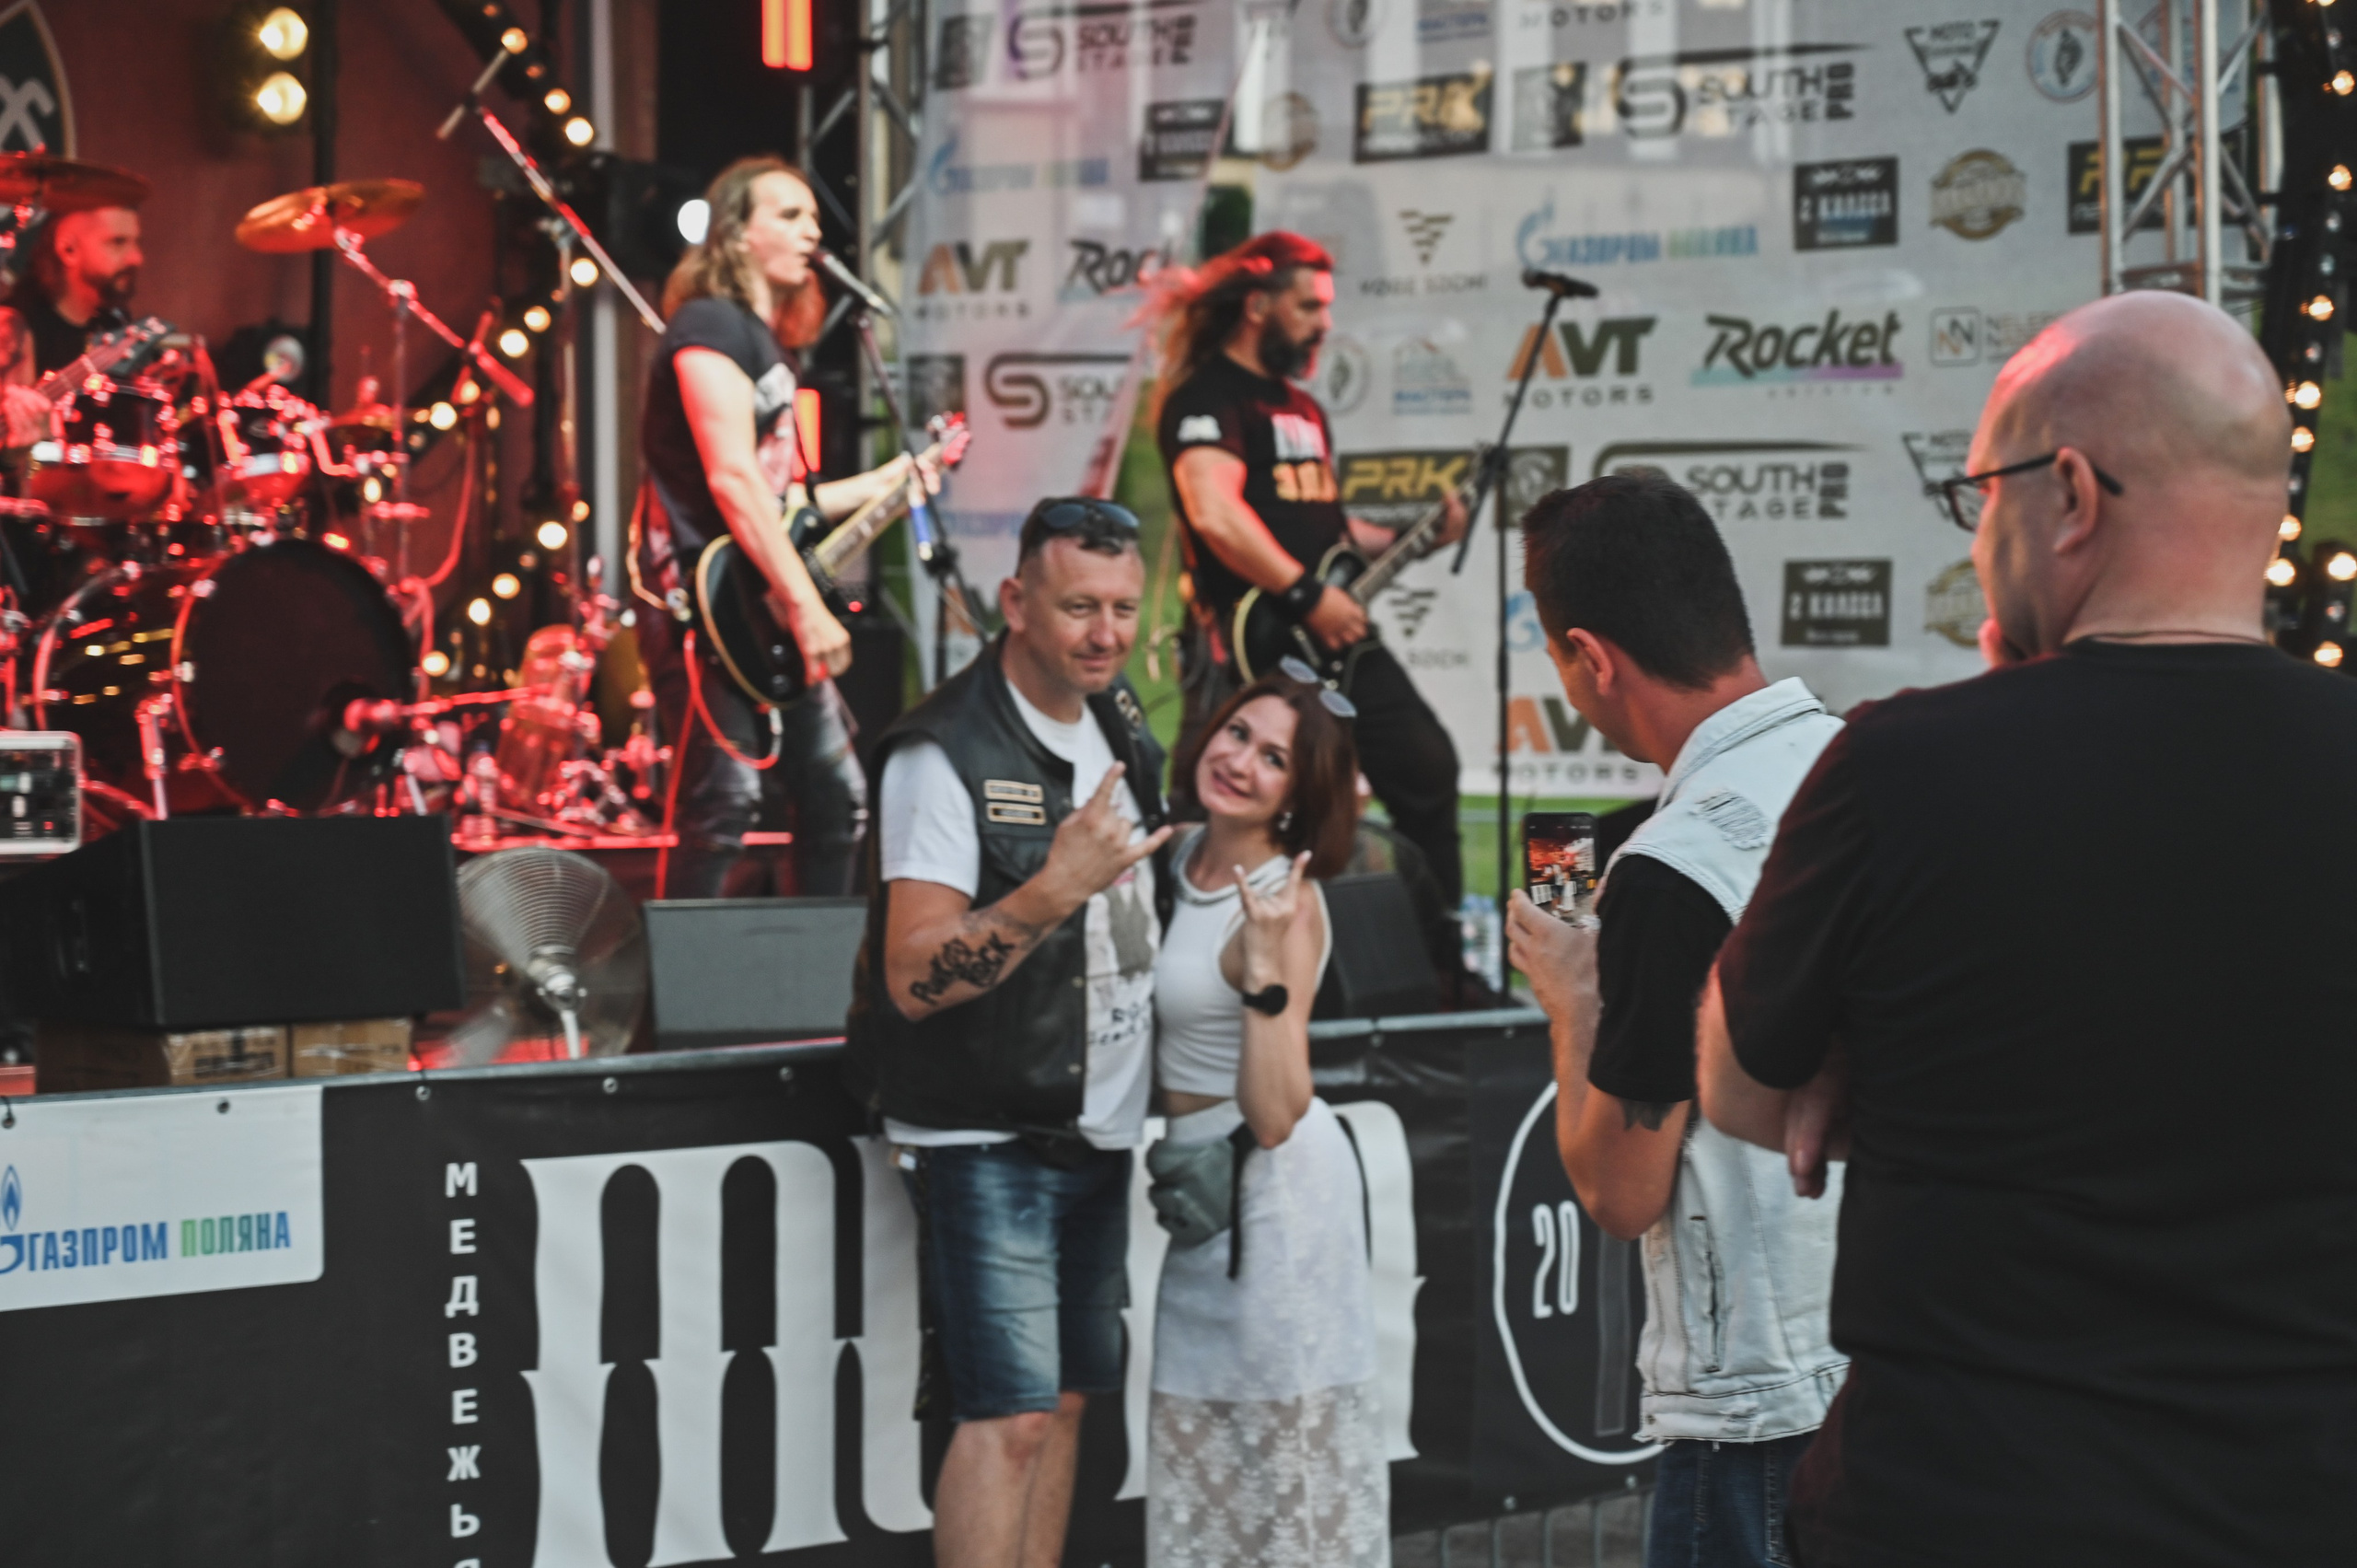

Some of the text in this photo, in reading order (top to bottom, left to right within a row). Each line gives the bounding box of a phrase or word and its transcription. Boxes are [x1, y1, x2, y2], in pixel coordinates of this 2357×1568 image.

[917, 238, 1030, 295] AVT
[1506, 317, 1659, 381] AVT
[1704, 307, 1903, 379] Rocket
[1343, 457, 1467, 499] PRK
[1687, 462, 1817, 495] SOUTH
[1713, 497, 1812, 520] TAGE
[1496, 696, 1619, 754] AV
[28, 1211, 292, 1272] ГАЗПРОМ ПОЛЯНА
